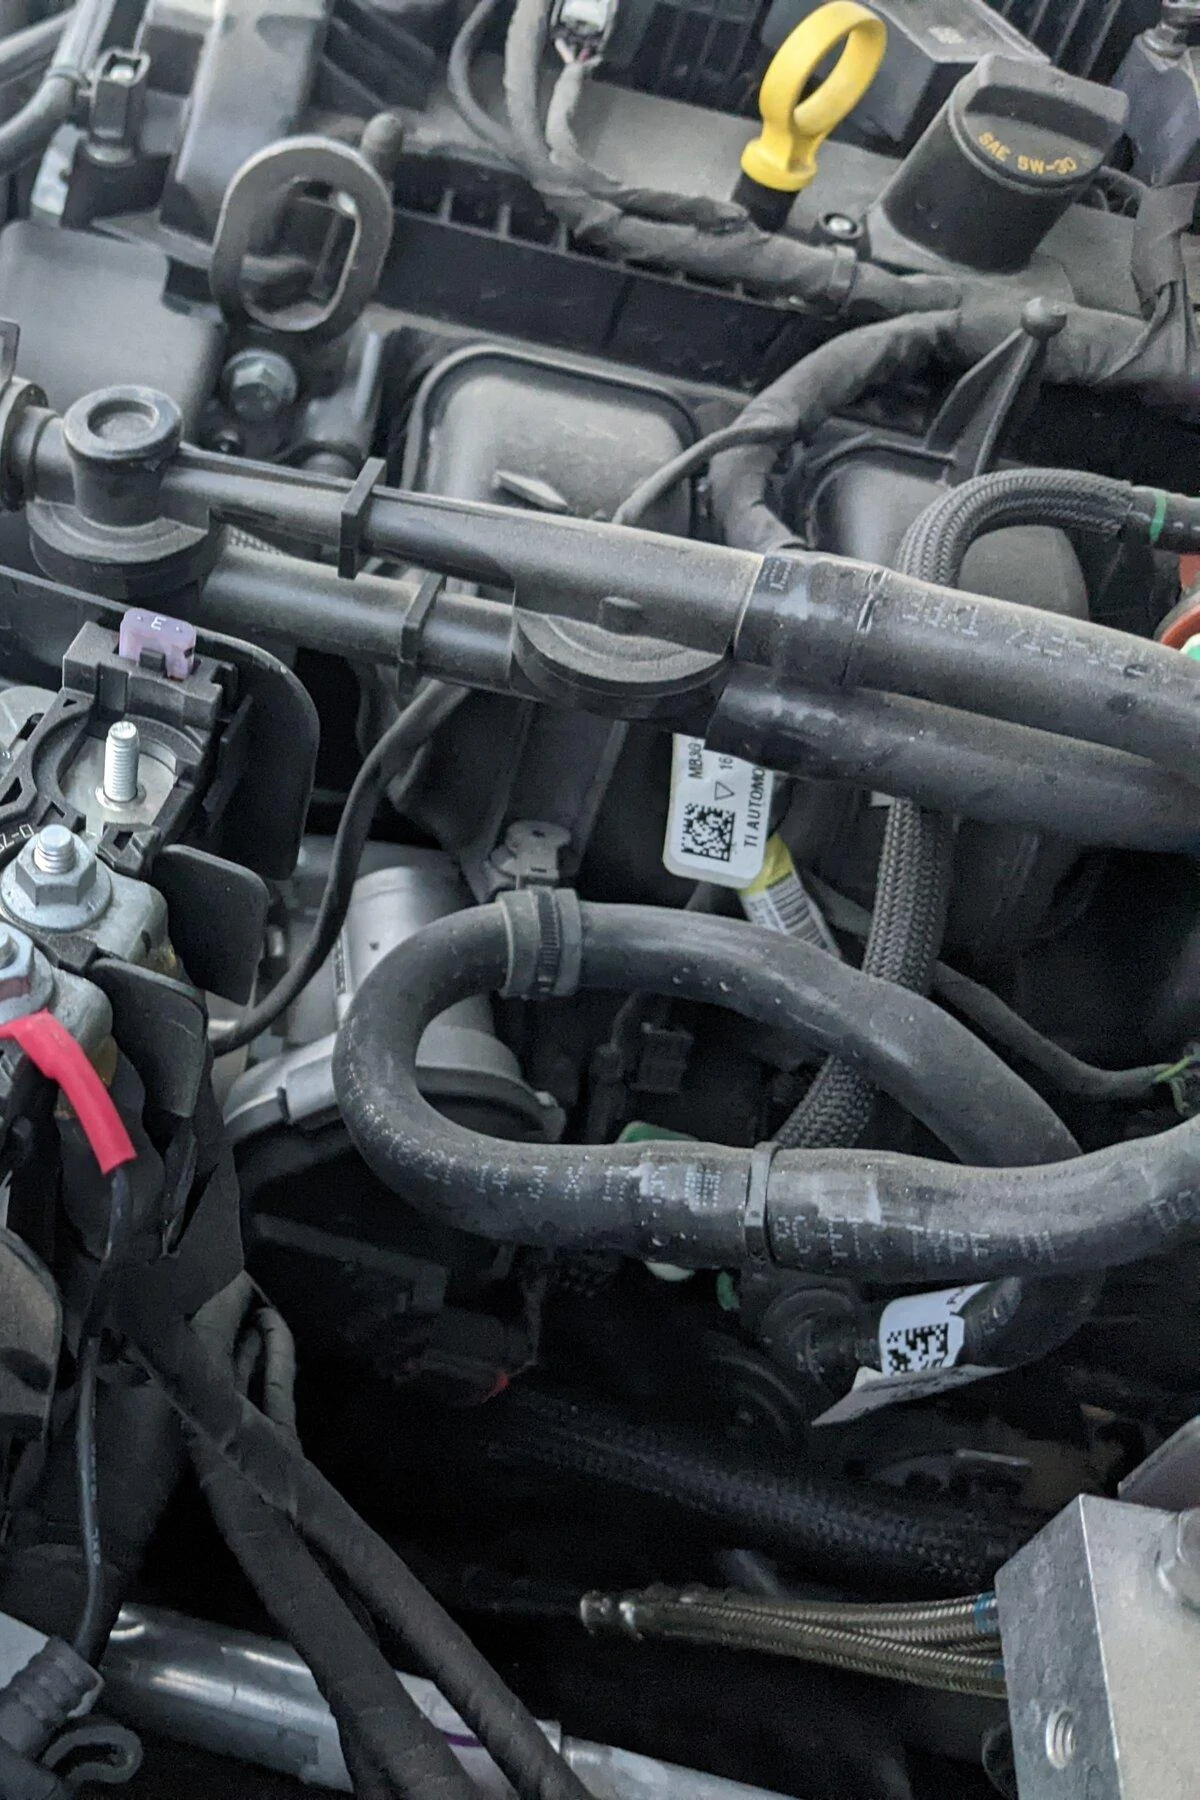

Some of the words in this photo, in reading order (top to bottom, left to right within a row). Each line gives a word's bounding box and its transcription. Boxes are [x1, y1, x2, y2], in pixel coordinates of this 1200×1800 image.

[979, 132, 1011, 162] SAE
[1018, 154, 1078, 175] 5W-30
[744, 834, 759, 848] TI
